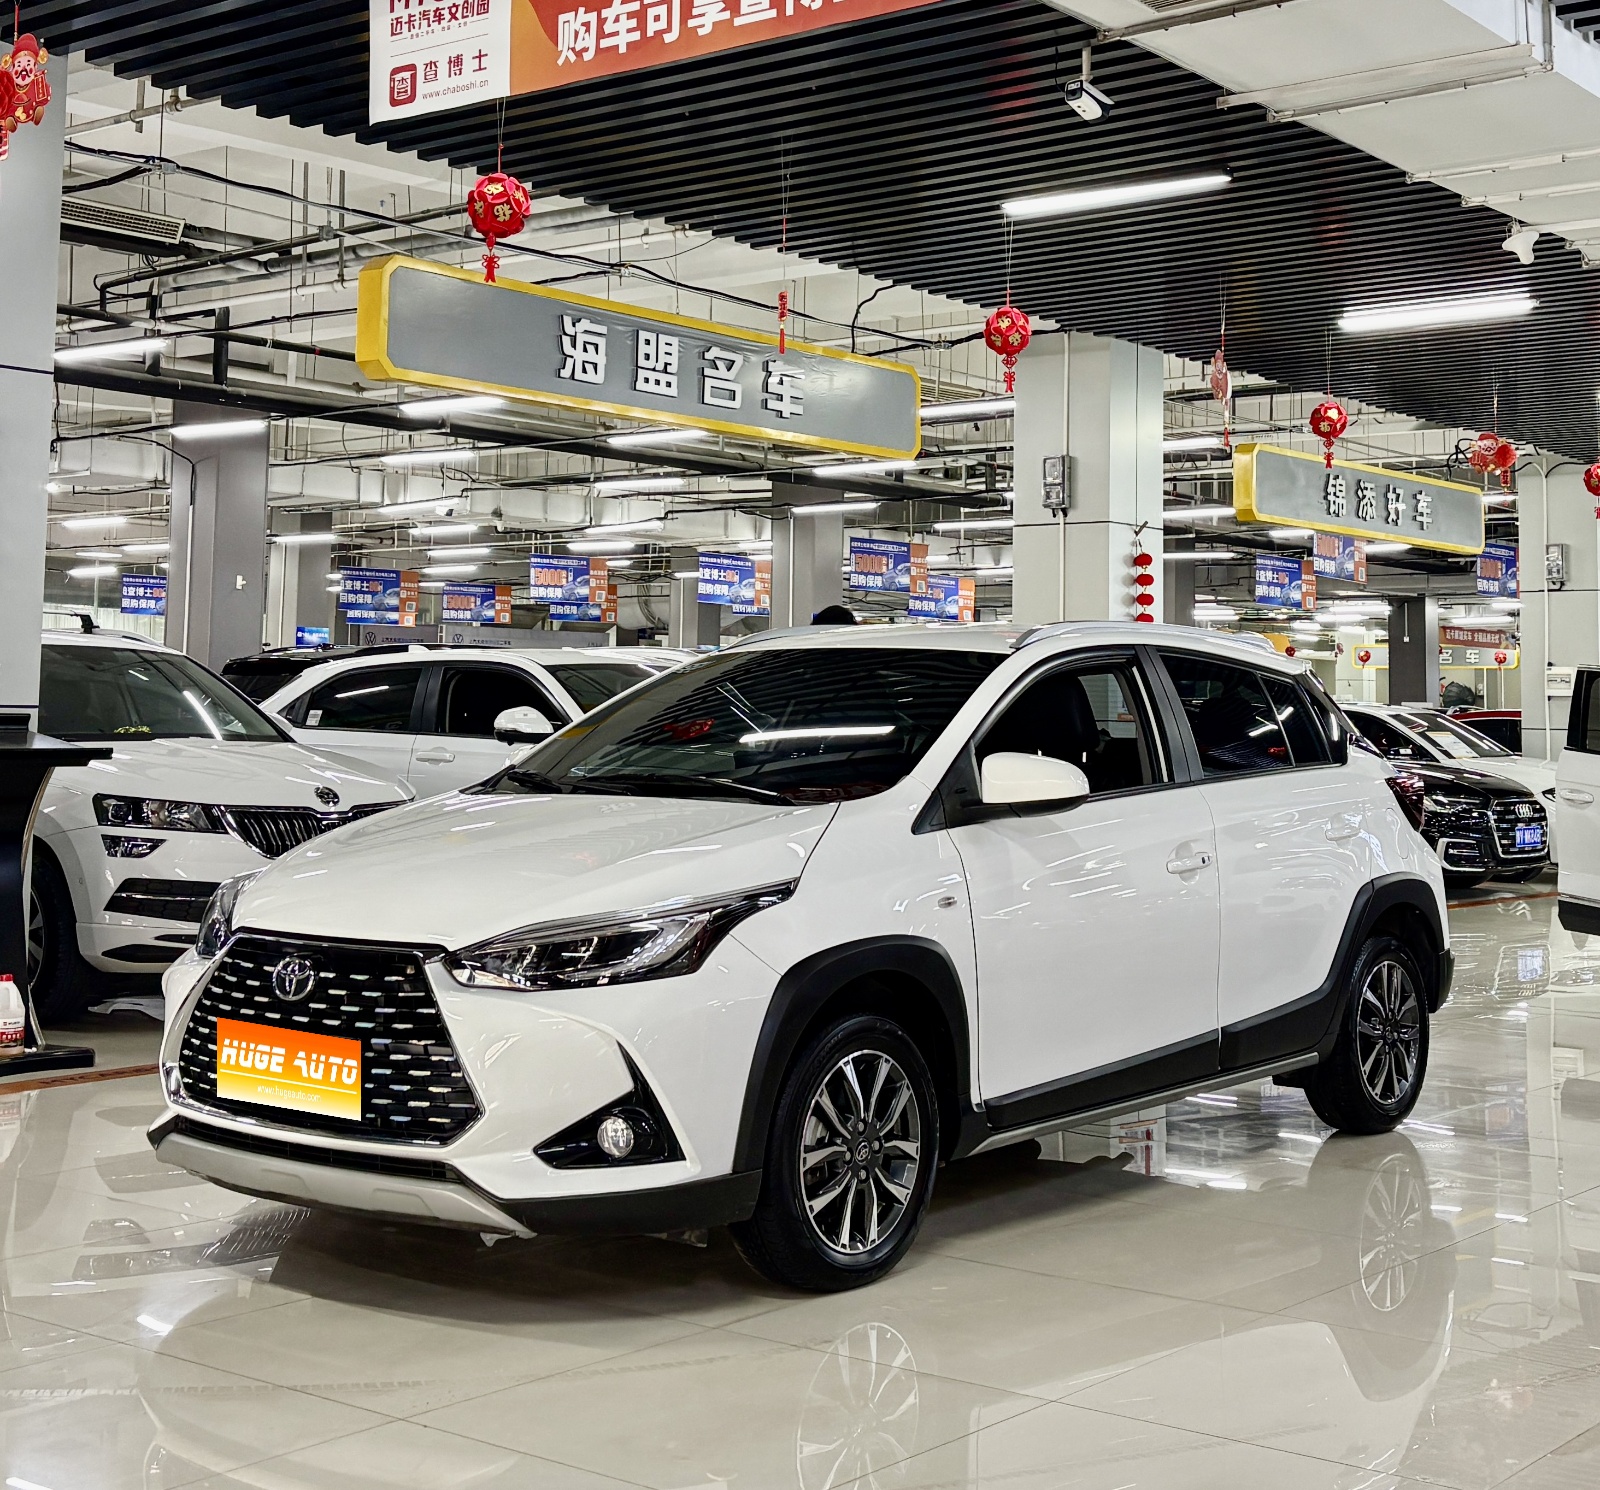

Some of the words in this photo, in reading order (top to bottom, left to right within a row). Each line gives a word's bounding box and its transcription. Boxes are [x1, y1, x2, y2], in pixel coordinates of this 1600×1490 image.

[390, 0, 490, 37] 迈卡汽车文创园
[556, 0, 857, 66] 购车可享
[422, 49, 489, 84] 查博士
[421, 79, 489, 100] www.chaboshi.cn
[557, 314, 806, 419] 海盟名车
[1324, 473, 1433, 531] 锦添好车
[850, 573, 883, 587] 回购保障
[121, 597, 156, 610] 回购保障
